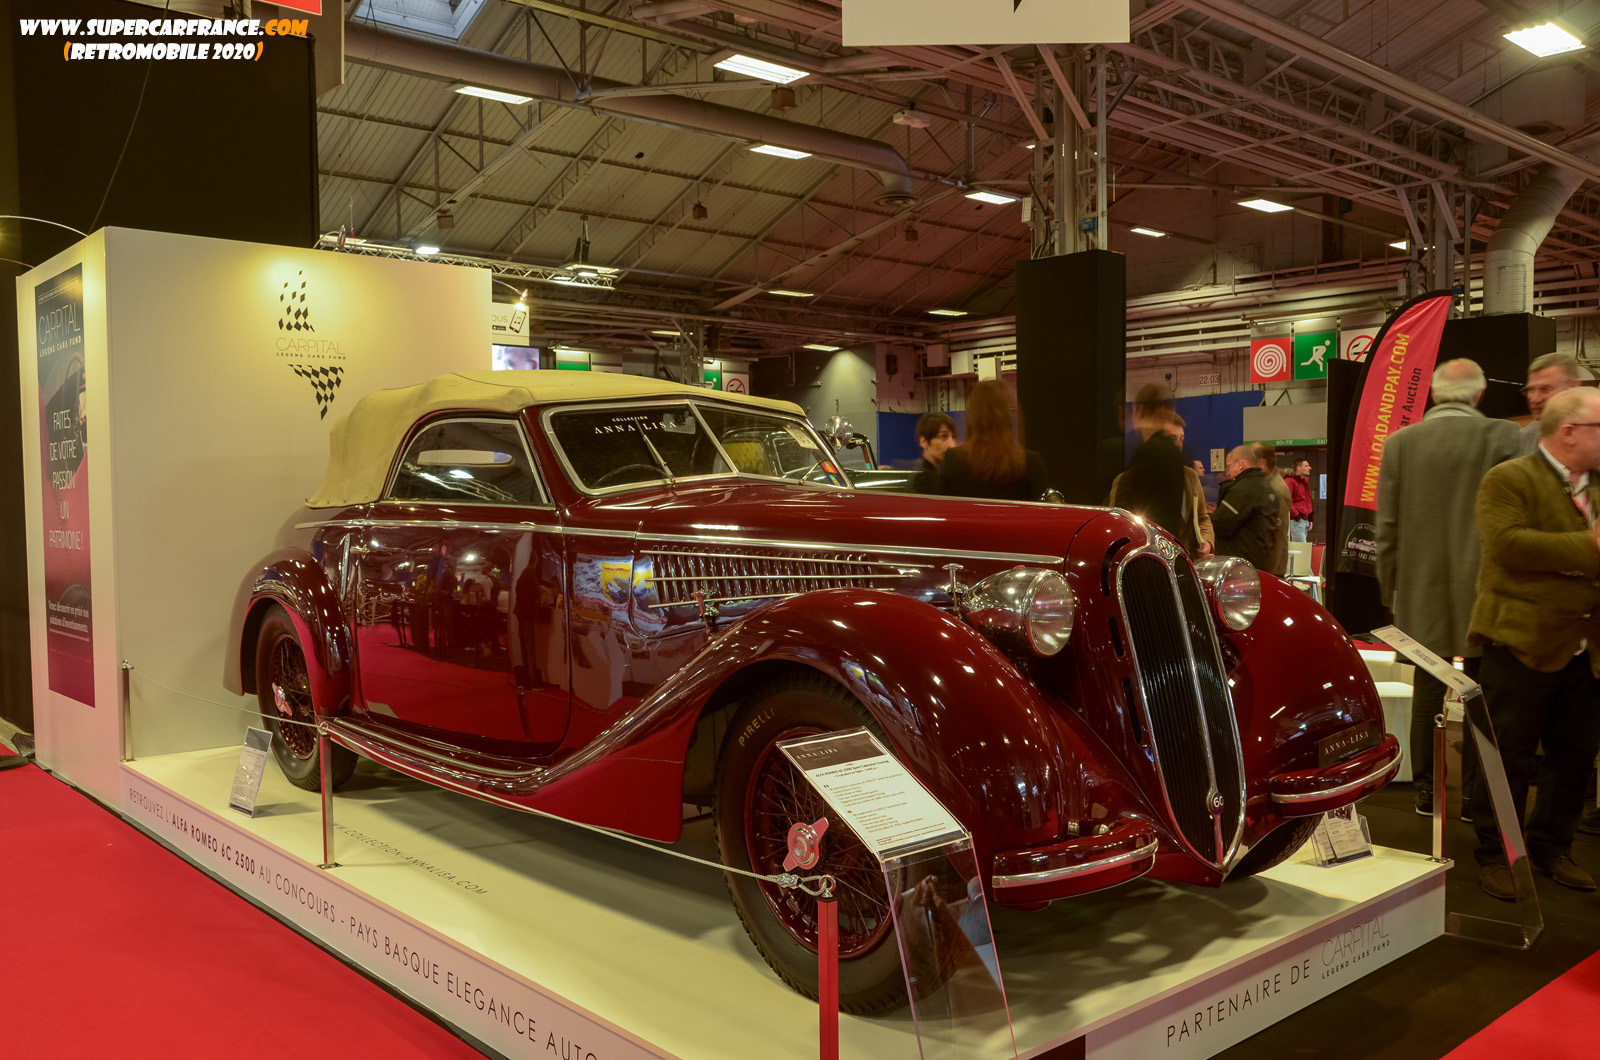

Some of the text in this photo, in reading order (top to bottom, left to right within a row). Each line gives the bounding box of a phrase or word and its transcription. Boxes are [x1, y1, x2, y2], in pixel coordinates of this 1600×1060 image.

[38, 301, 81, 345] CARPITAL
[39, 335, 81, 358] LEGEND CARS FUND
[276, 337, 345, 355] CARPITAL
[1402, 367, 1422, 413] Auction
[53, 409, 71, 431] FAITES
[594, 421, 677, 434] ANNA LISA
[1361, 333, 1410, 502] WWW.LOADANDPAY.COM
[50, 439, 77, 461] DE VOTRE
[52, 470, 76, 490] PASSION
[60, 500, 69, 520] UN
[738, 707, 775, 747] PIRELLI
[129, 787, 164, 820] RETROUVEZ
[190, 824, 218, 853] ROMEO
[221, 842, 232, 861] 6C
[235, 850, 255, 875] 2500
[258, 864, 271, 884] AU
[275, 873, 335, 923] CONCOURS
[350, 916, 378, 949] PAYS
[384, 936, 439, 985] BASQUE
[447, 971, 536, 1043] ELEGANCE
[1322, 939, 1391, 979] LEGEND CARS FUND
[1167, 913, 1389, 1047] PARTENAIRE DE CARPITAL
